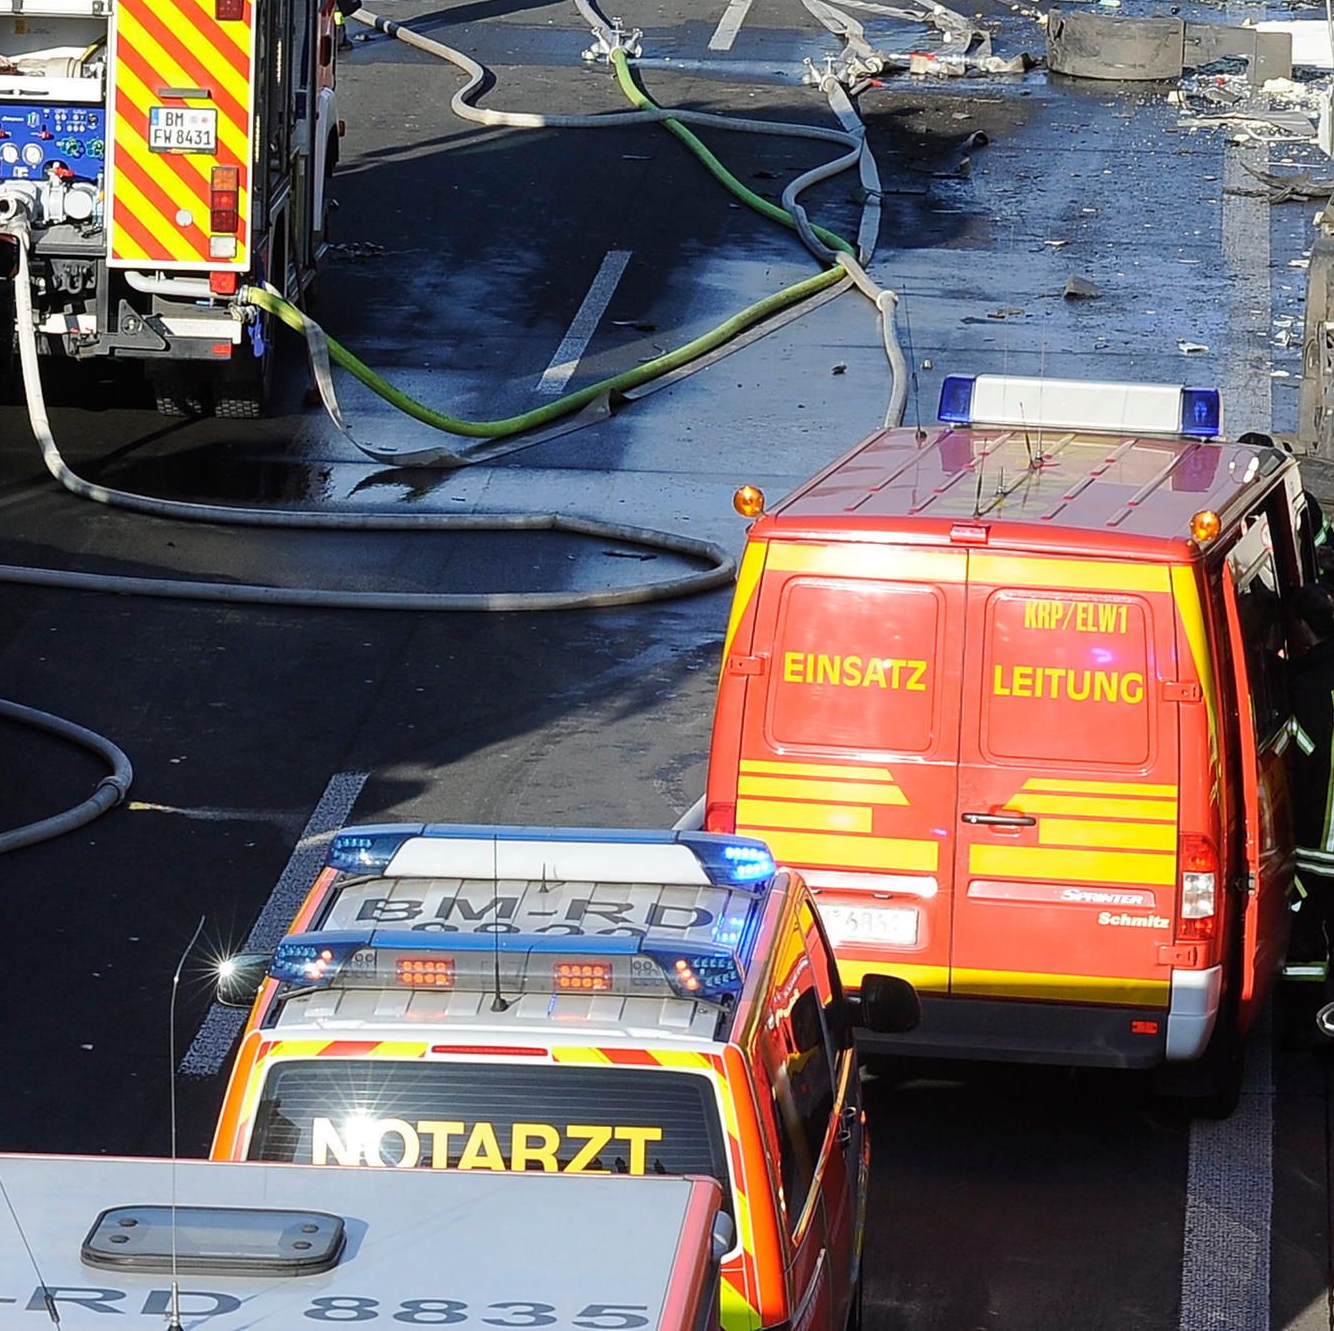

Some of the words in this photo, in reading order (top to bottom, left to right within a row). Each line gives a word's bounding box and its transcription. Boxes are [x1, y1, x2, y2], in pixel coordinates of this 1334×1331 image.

[166, 112, 184, 127] BM
[153, 129, 172, 144] FW
[176, 130, 211, 145] 8431
[1024, 600, 1129, 634] KRP/ELW1
[784, 652, 928, 691] EINSATZ
[993, 665, 1144, 704] LEITUNG
[355, 897, 713, 930] BM-RD
[1098, 911, 1170, 929] Schmitz
[311, 1117, 663, 1176] NOTARZT
[302, 1295, 652, 1330] 8835
